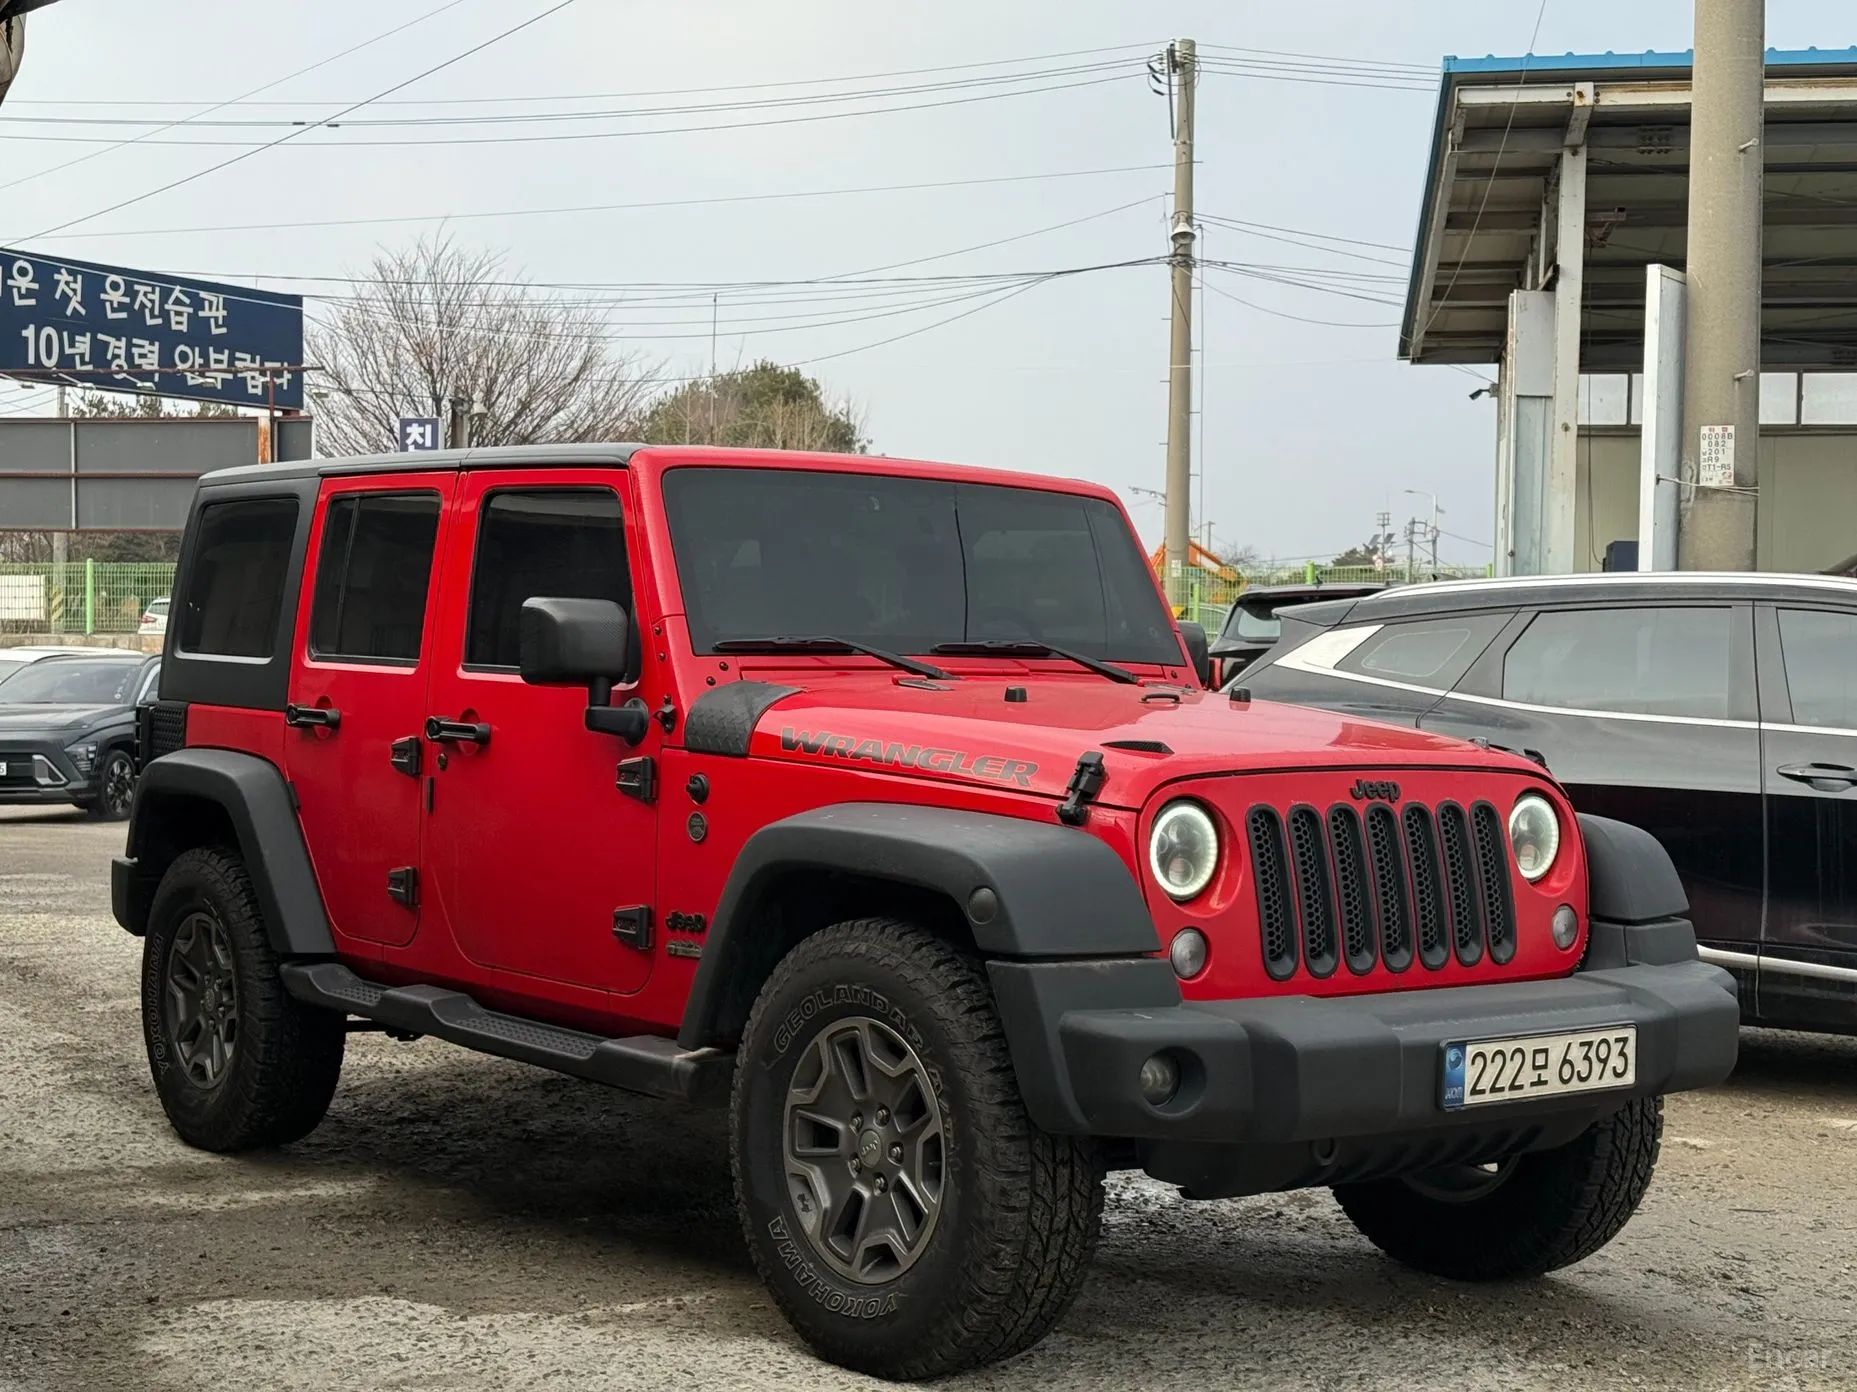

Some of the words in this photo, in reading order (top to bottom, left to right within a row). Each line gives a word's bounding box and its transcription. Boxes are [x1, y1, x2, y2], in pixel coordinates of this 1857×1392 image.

[0, 259, 39, 306] 운
[53, 267, 87, 317] 첫
[100, 274, 229, 336] 운전습관
[174, 343, 293, 396] 안부럽다
[780, 726, 1040, 788] WRANGLER
[1349, 778, 1402, 804] Jeep
[773, 984, 925, 1053] GEOLANDAR
[1469, 1047, 1549, 1096] 222모
[1558, 1036, 1630, 1085] 6393
[767, 1215, 898, 1319] YOKOHAMA
